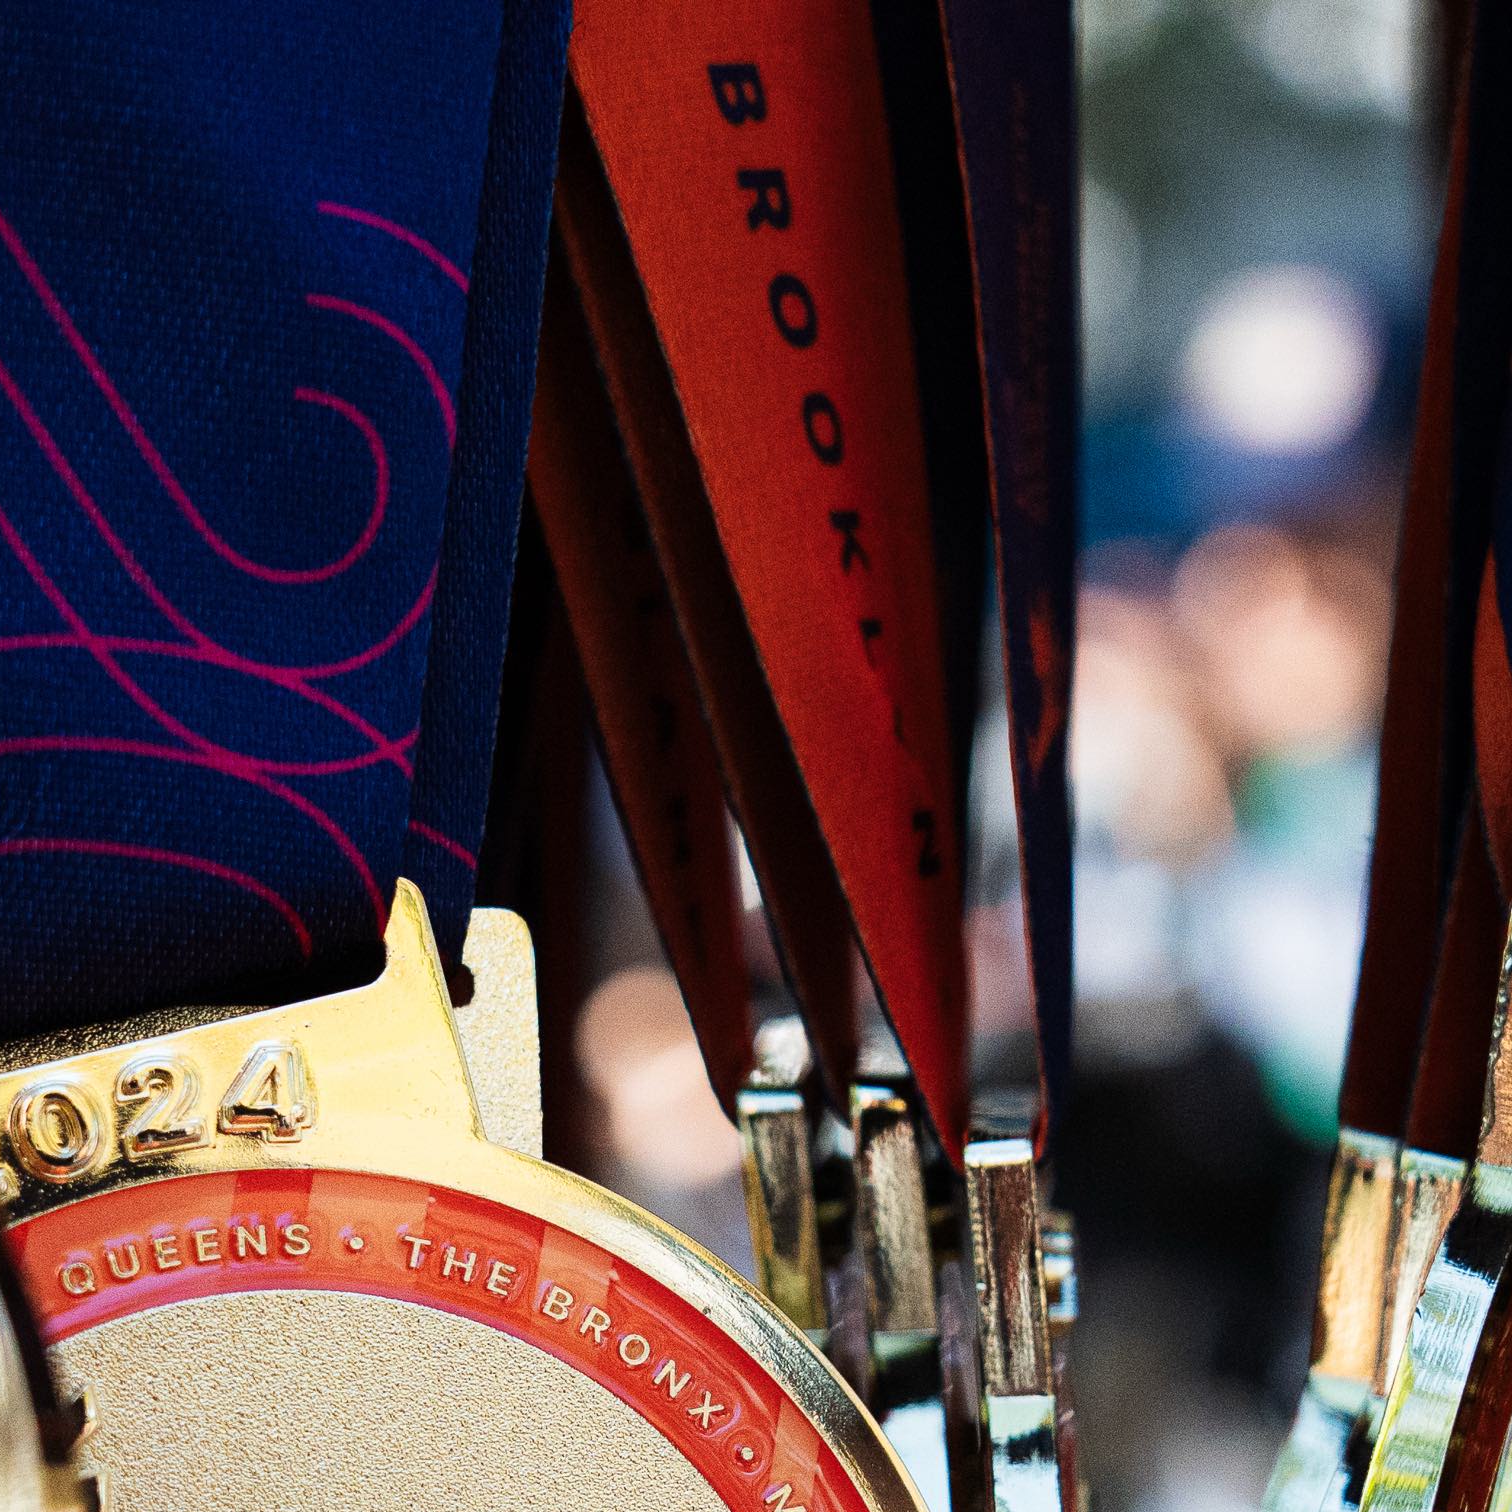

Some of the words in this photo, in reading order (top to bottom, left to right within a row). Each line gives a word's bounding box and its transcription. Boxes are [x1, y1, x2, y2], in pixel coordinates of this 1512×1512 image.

[706, 60, 943, 880] BROOKLN
[59, 1222, 314, 1297] QUEENS
[402, 1233, 518, 1299] THE
[541, 1281, 728, 1431] BRONX
